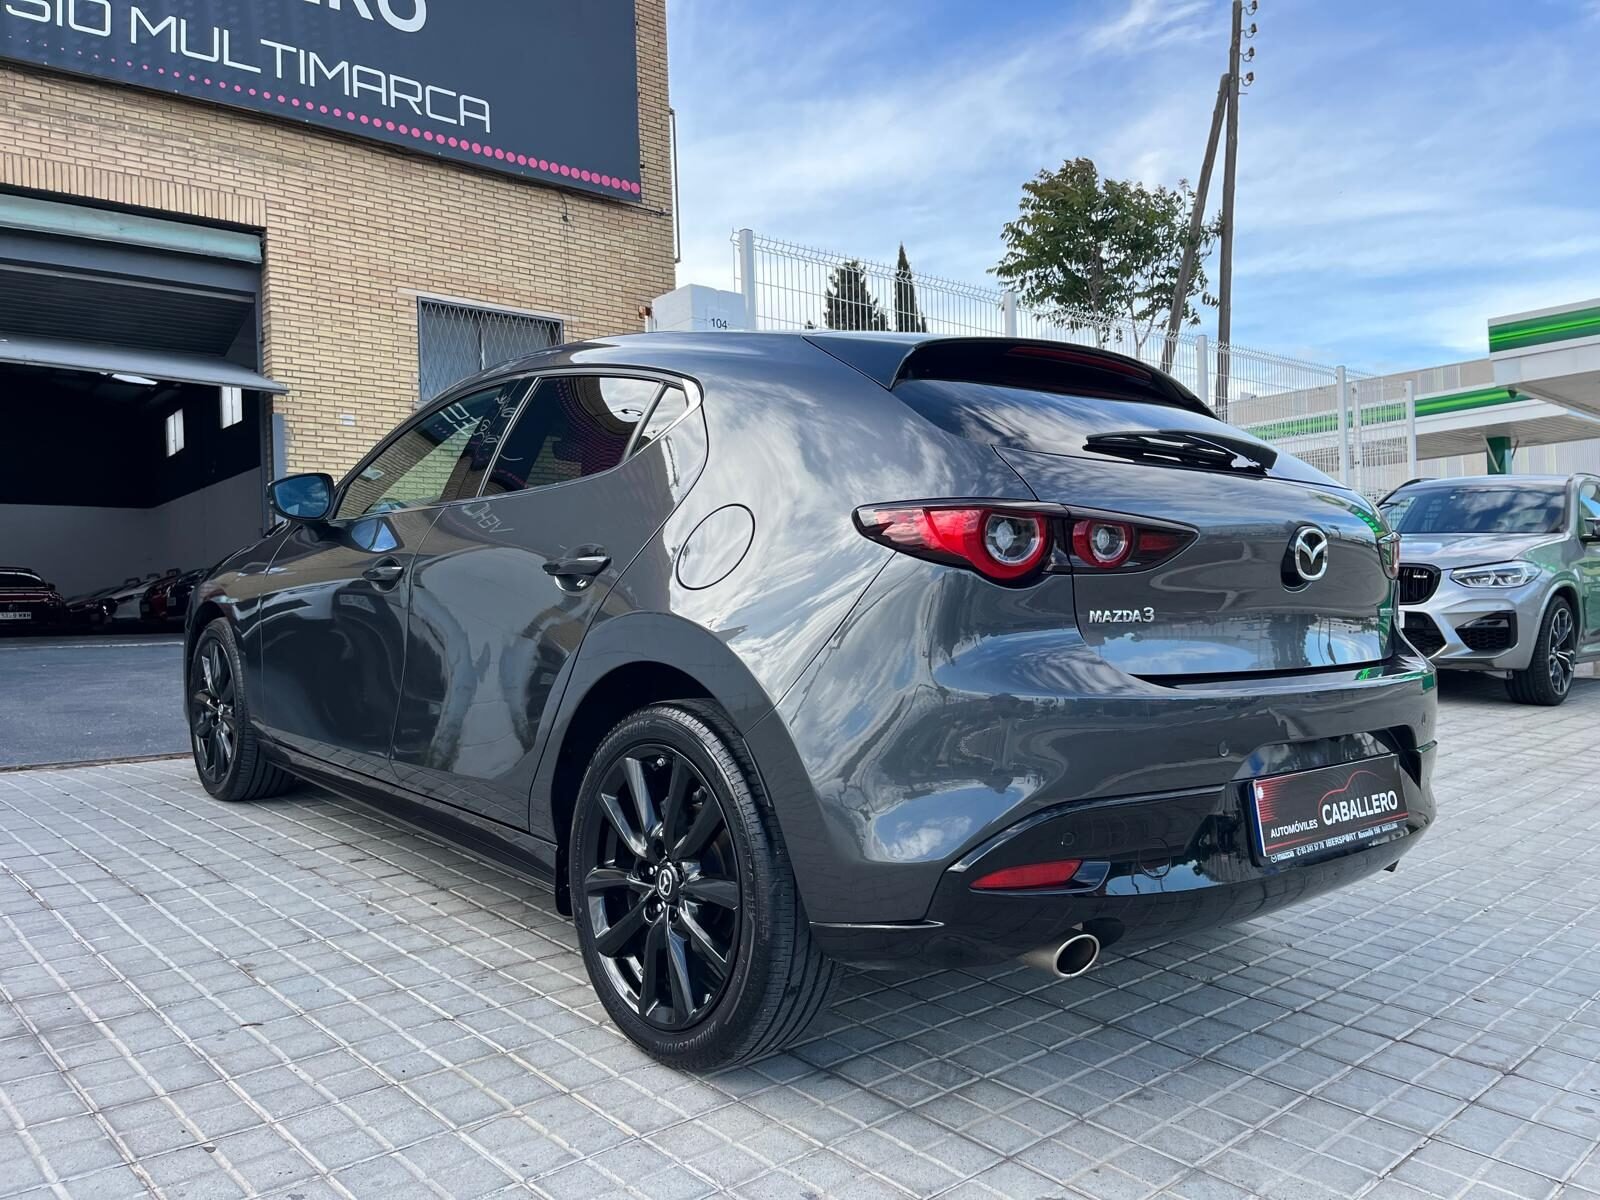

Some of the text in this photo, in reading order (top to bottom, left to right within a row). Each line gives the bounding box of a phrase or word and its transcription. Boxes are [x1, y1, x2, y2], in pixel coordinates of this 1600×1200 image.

[131, 6, 491, 133] MULTIMARCA
[711, 318, 728, 330] 104
[1270, 790, 1398, 839] AUTOMÓVILES CABALLERO
